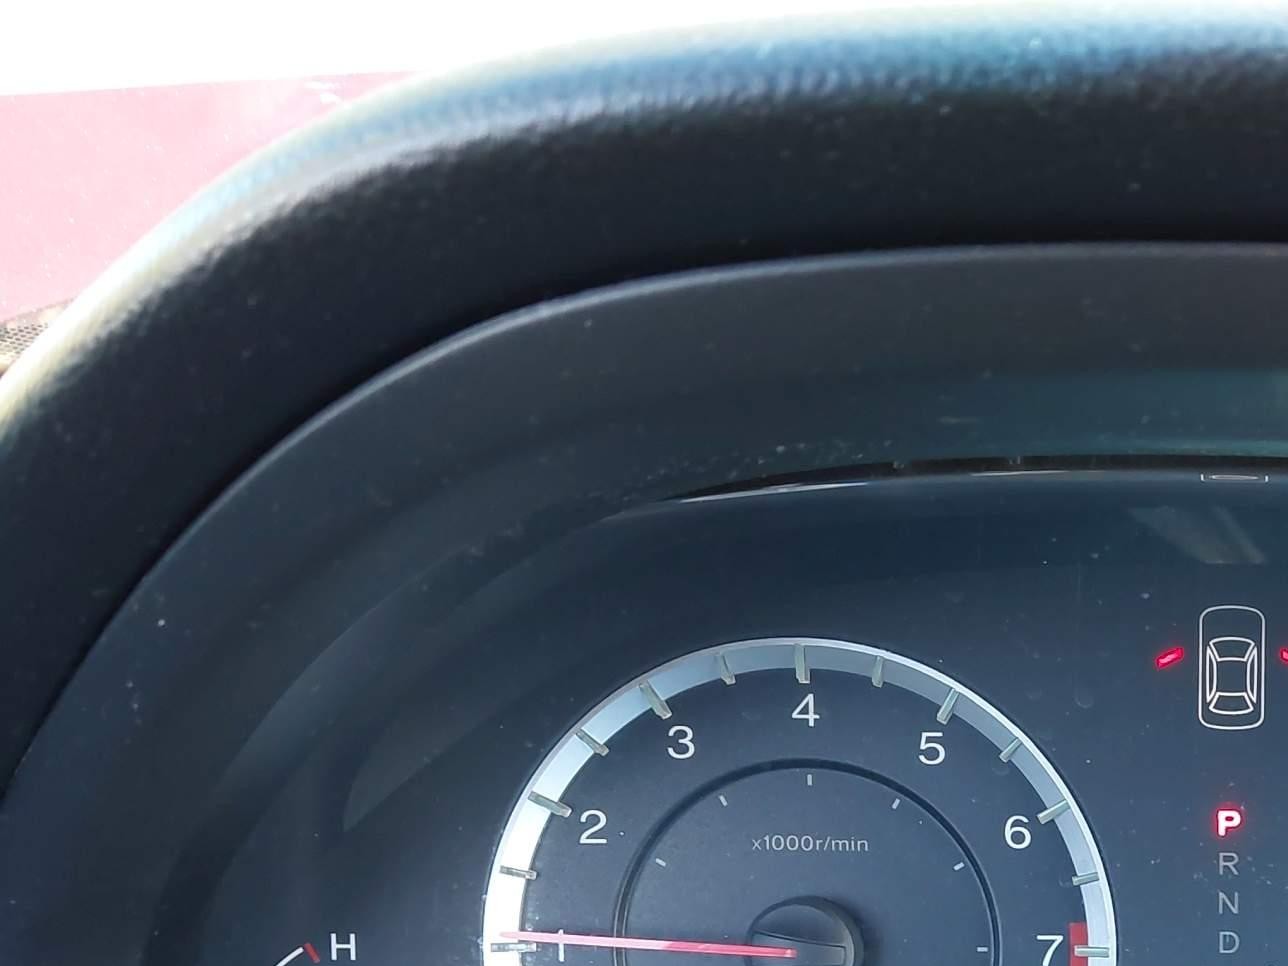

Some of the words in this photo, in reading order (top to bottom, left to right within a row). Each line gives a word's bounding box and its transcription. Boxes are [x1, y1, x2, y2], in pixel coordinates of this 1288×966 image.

[792, 694, 819, 726] 4
[668, 726, 694, 758] 3
[919, 732, 945, 764] 5
[580, 810, 607, 843] 2
[1005, 816, 1031, 849] 6
[1215, 808, 1243, 838] P
[753, 835, 868, 851] x1000r/min
[1220, 853, 1238, 875] R
[1219, 892, 1238, 914] N
[331, 934, 355, 960] H
[1037, 935, 1063, 966] 7
[1220, 932, 1239, 953] D
